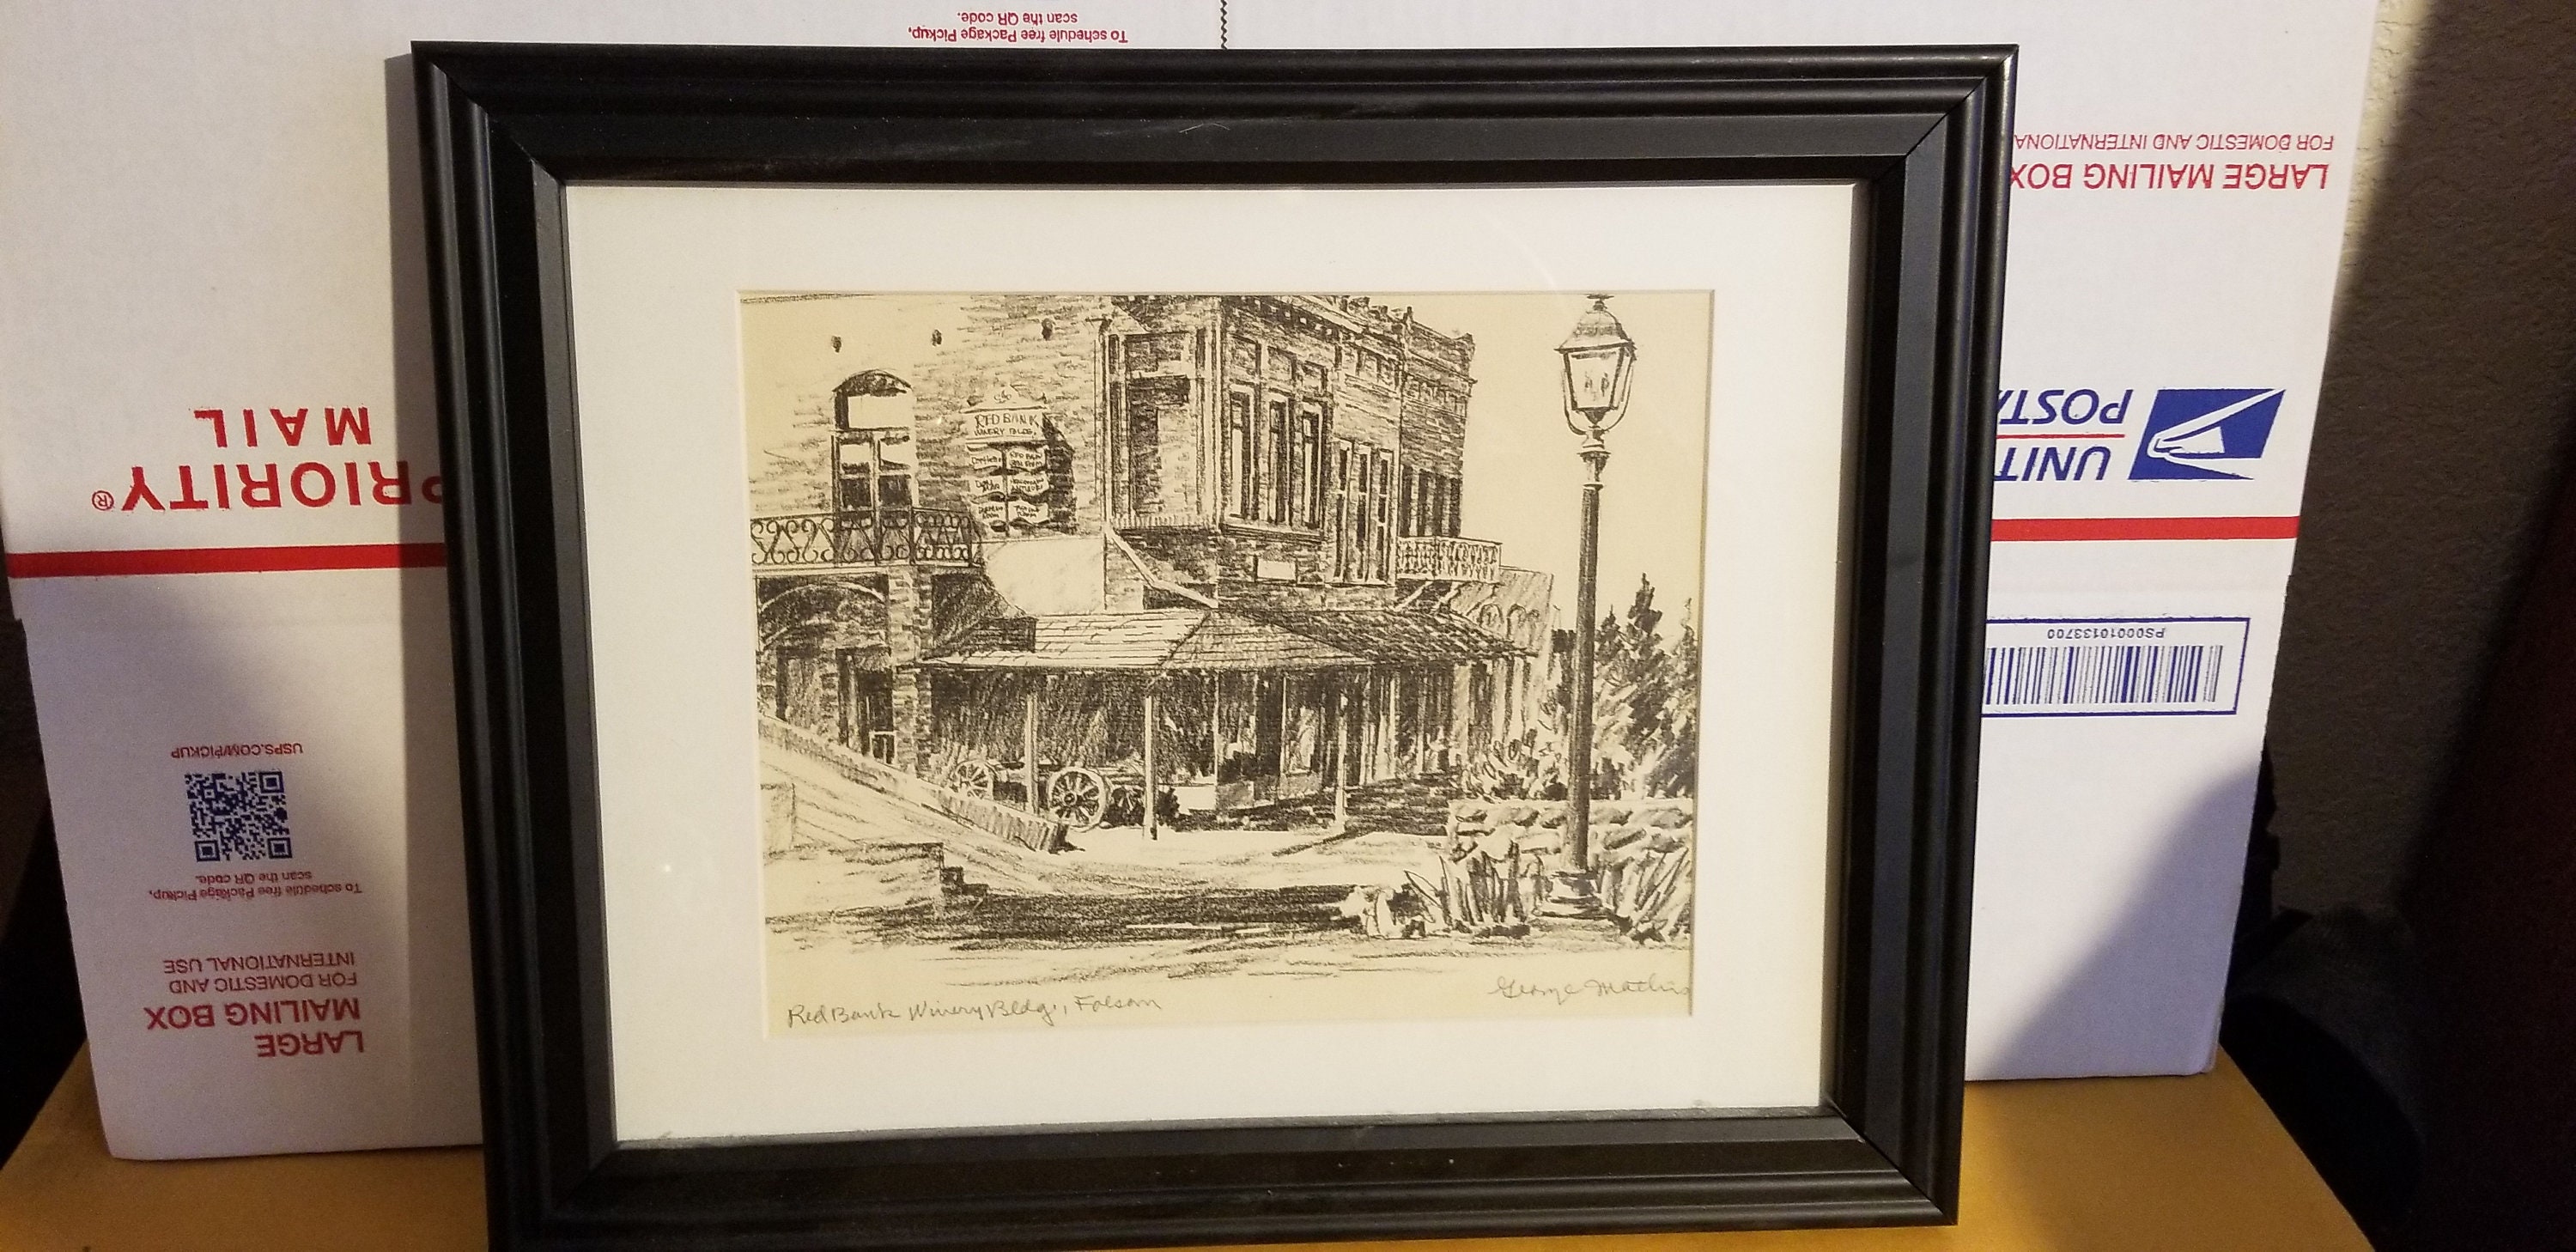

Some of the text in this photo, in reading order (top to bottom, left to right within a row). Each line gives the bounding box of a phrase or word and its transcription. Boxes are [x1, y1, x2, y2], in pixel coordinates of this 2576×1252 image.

[957, 11, 1078, 26] scan the QR code.
[908, 27, 1129, 43] To schedule free Package Pickup,
[2153, 134, 2192, 151] AND
[2196, 134, 2292, 151] DOMESTIC
[2297, 134, 2335, 151] FOR
[2011, 162, 2330, 190] LARGE MAILING BOX
[193, 406, 372, 448] MAIL
[2046, 628, 2166, 640] PS00010133700
[171, 743, 303, 759] USPS.COM/PICKUP
[234, 873, 255, 884] QR
[258, 872, 279, 883] the
[283, 870, 313, 880] scan
[200, 886, 255, 901] Package
[258, 885, 282, 897] free
[286, 882, 342, 896] schedule
[345, 884, 362, 894] To
[162, 951, 355, 974] INTERNATIONAL USE
[169, 971, 357, 994] FOR DOMESTIC AND
[143, 997, 361, 1030] MAILING BOX
[254, 1030, 364, 1058] LARGE
